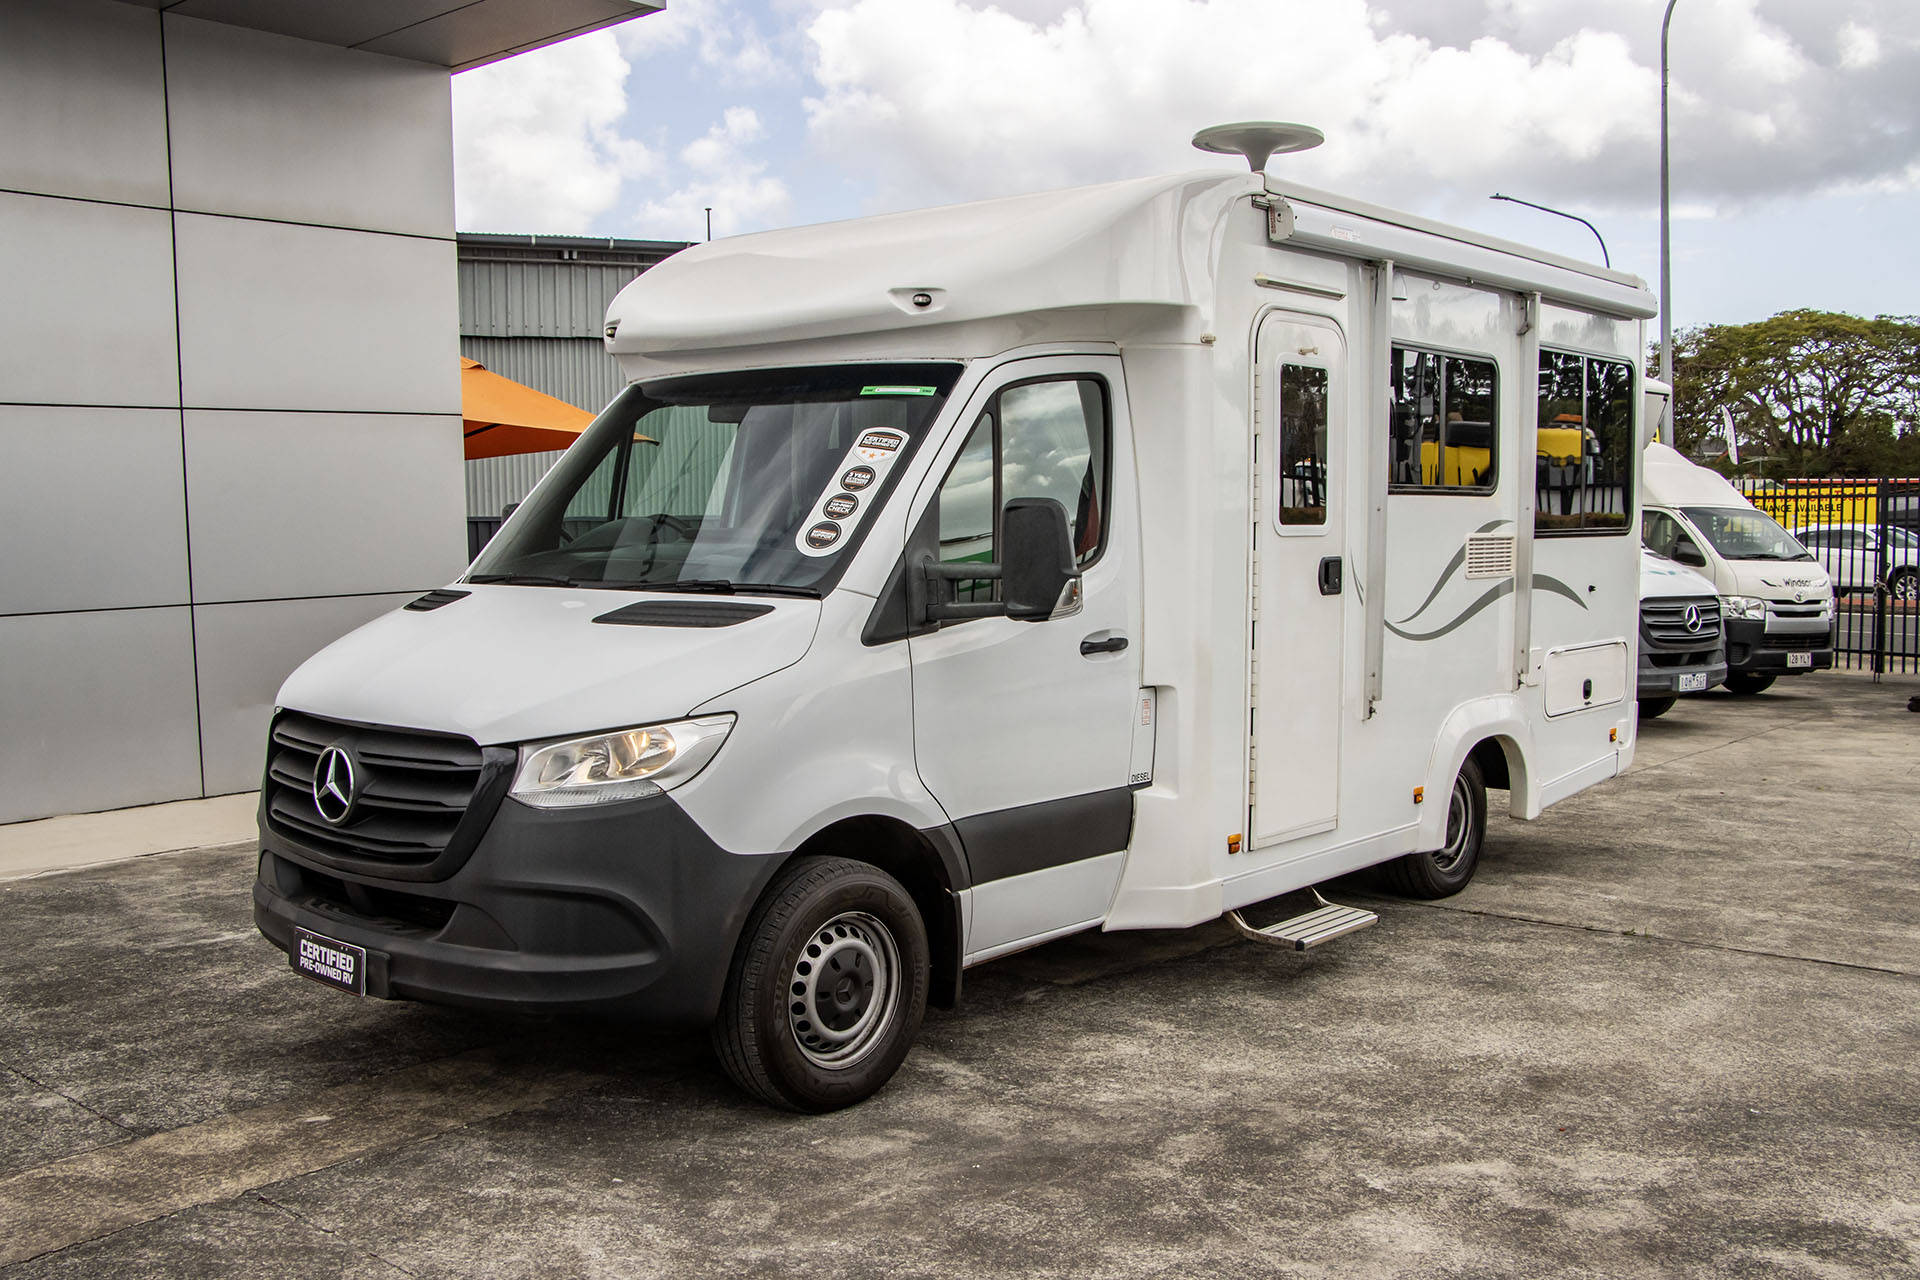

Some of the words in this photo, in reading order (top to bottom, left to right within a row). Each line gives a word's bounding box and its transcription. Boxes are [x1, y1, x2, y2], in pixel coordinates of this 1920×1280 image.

[864, 436, 900, 446] CERTIFIED
[1131, 772, 1150, 783] DIESEL
[300, 939, 354, 973] CERTIFIED
[300, 956, 342, 981] PRE-OWNED
[342, 971, 353, 985] RV
